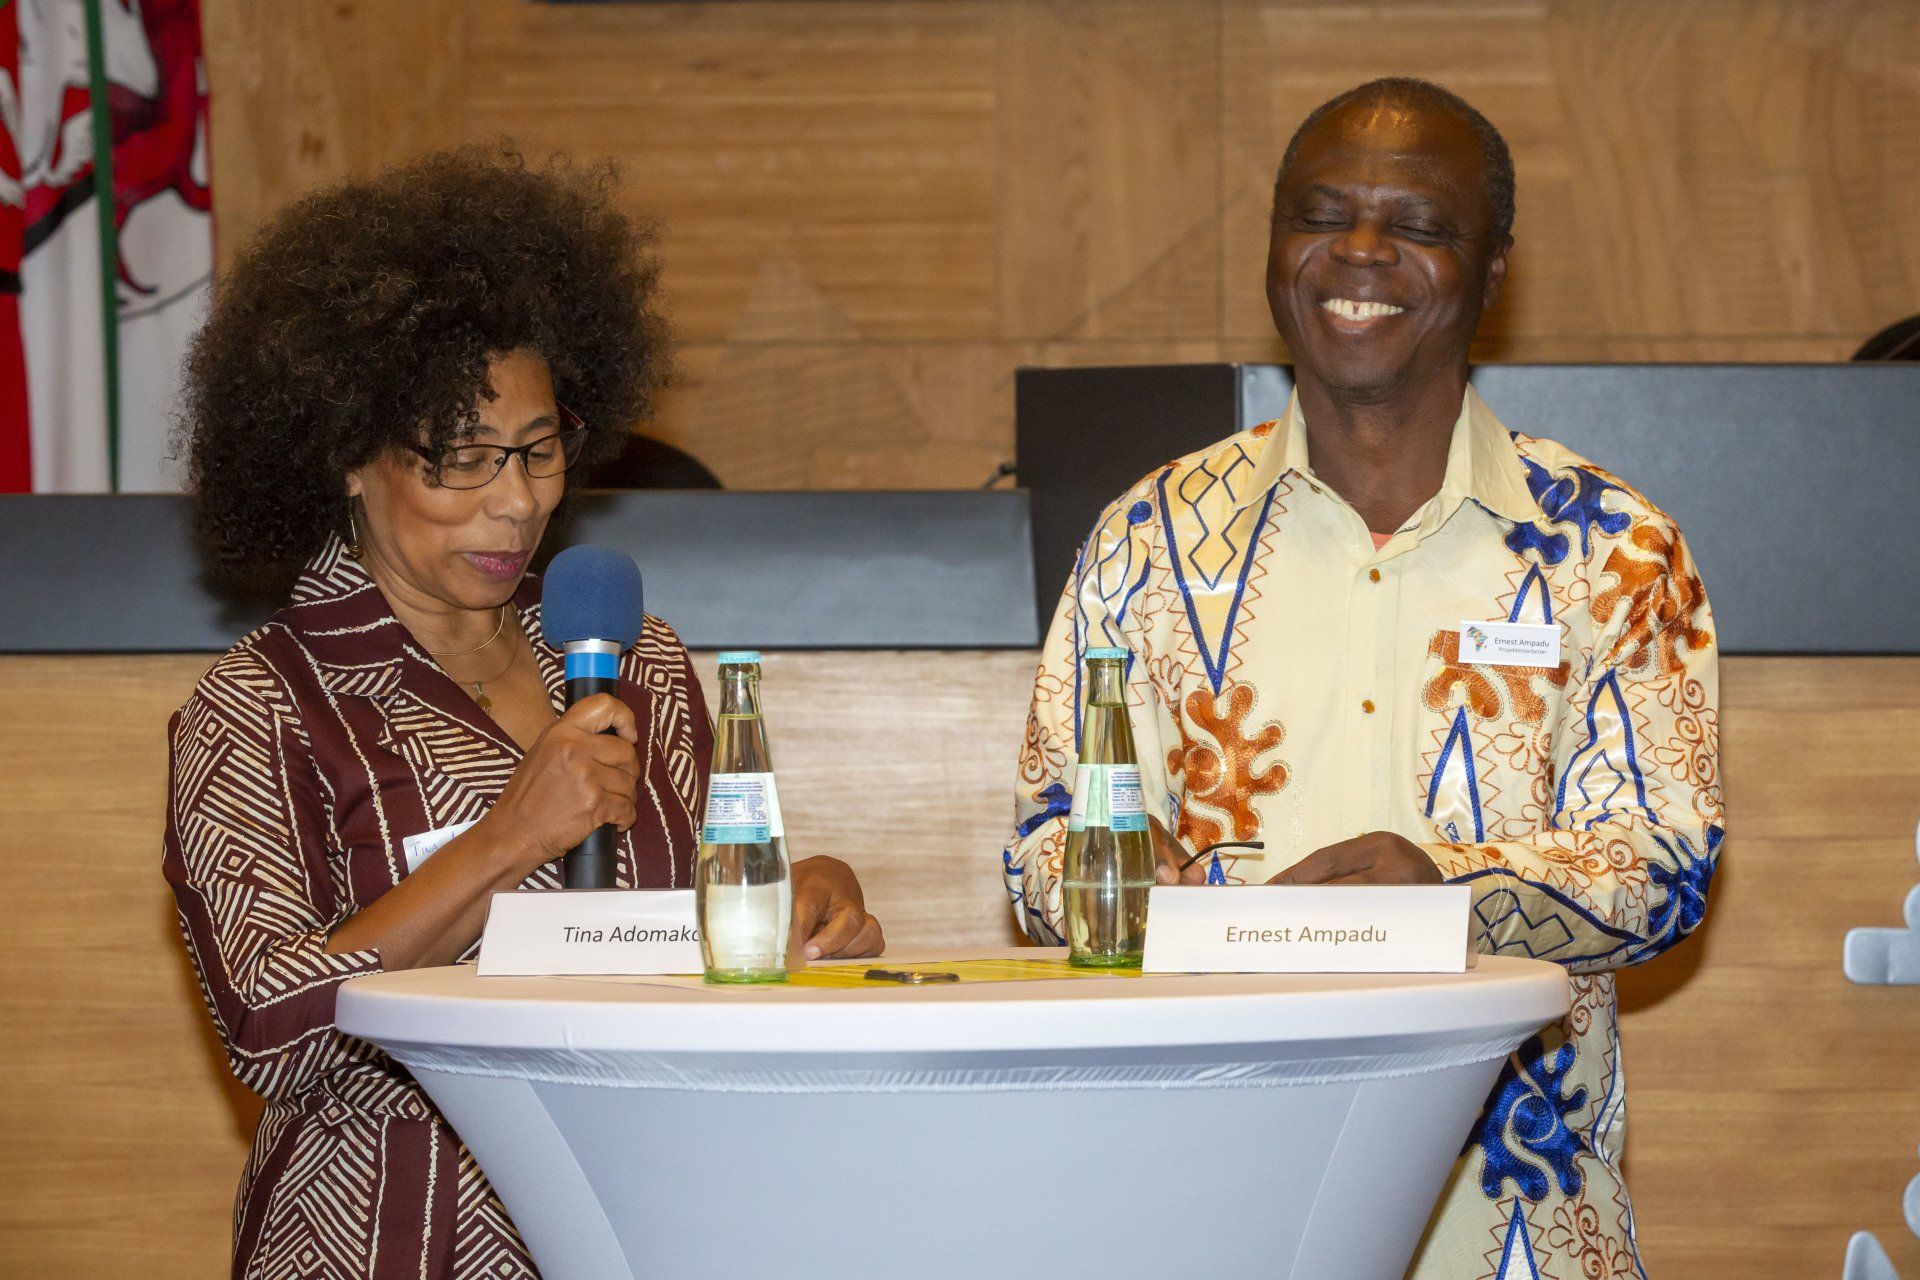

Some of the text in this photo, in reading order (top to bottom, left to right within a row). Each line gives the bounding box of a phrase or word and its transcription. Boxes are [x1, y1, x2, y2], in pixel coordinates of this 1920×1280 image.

[1494, 637, 1550, 648] Ernest Ampadu
[563, 926, 603, 943] Tina
[1226, 925, 1387, 946] Ernest Ampadu
